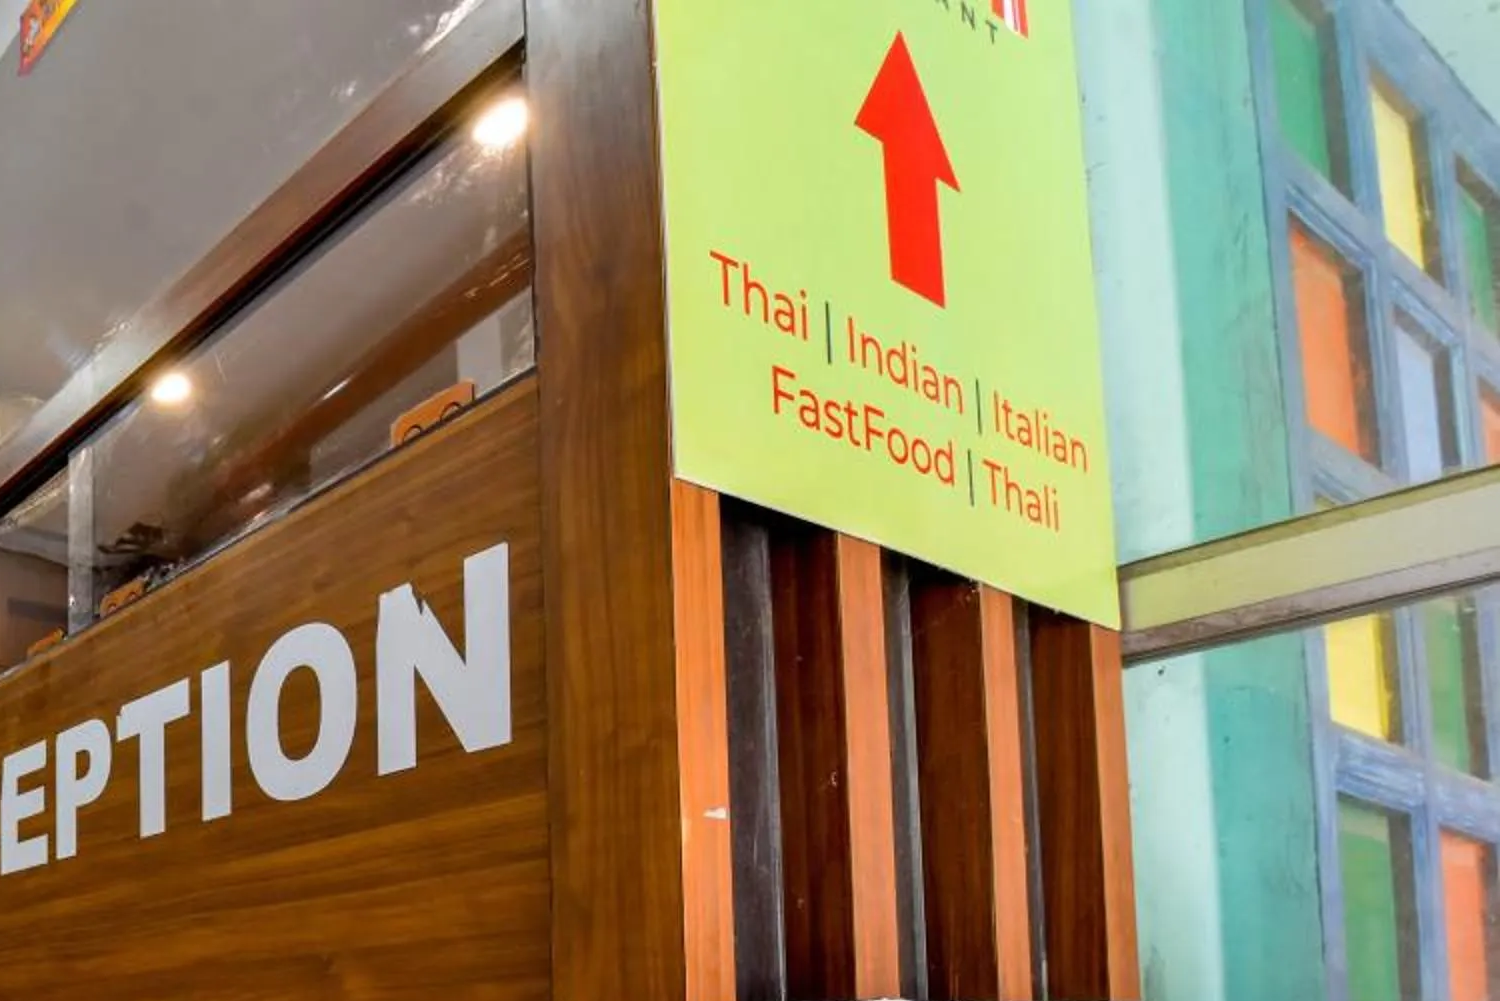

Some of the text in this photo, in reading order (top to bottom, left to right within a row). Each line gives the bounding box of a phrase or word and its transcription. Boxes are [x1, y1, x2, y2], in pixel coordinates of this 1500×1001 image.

[709, 250, 1088, 473] Thai Indian Italian
[771, 365, 1060, 532] FastFood Thali
